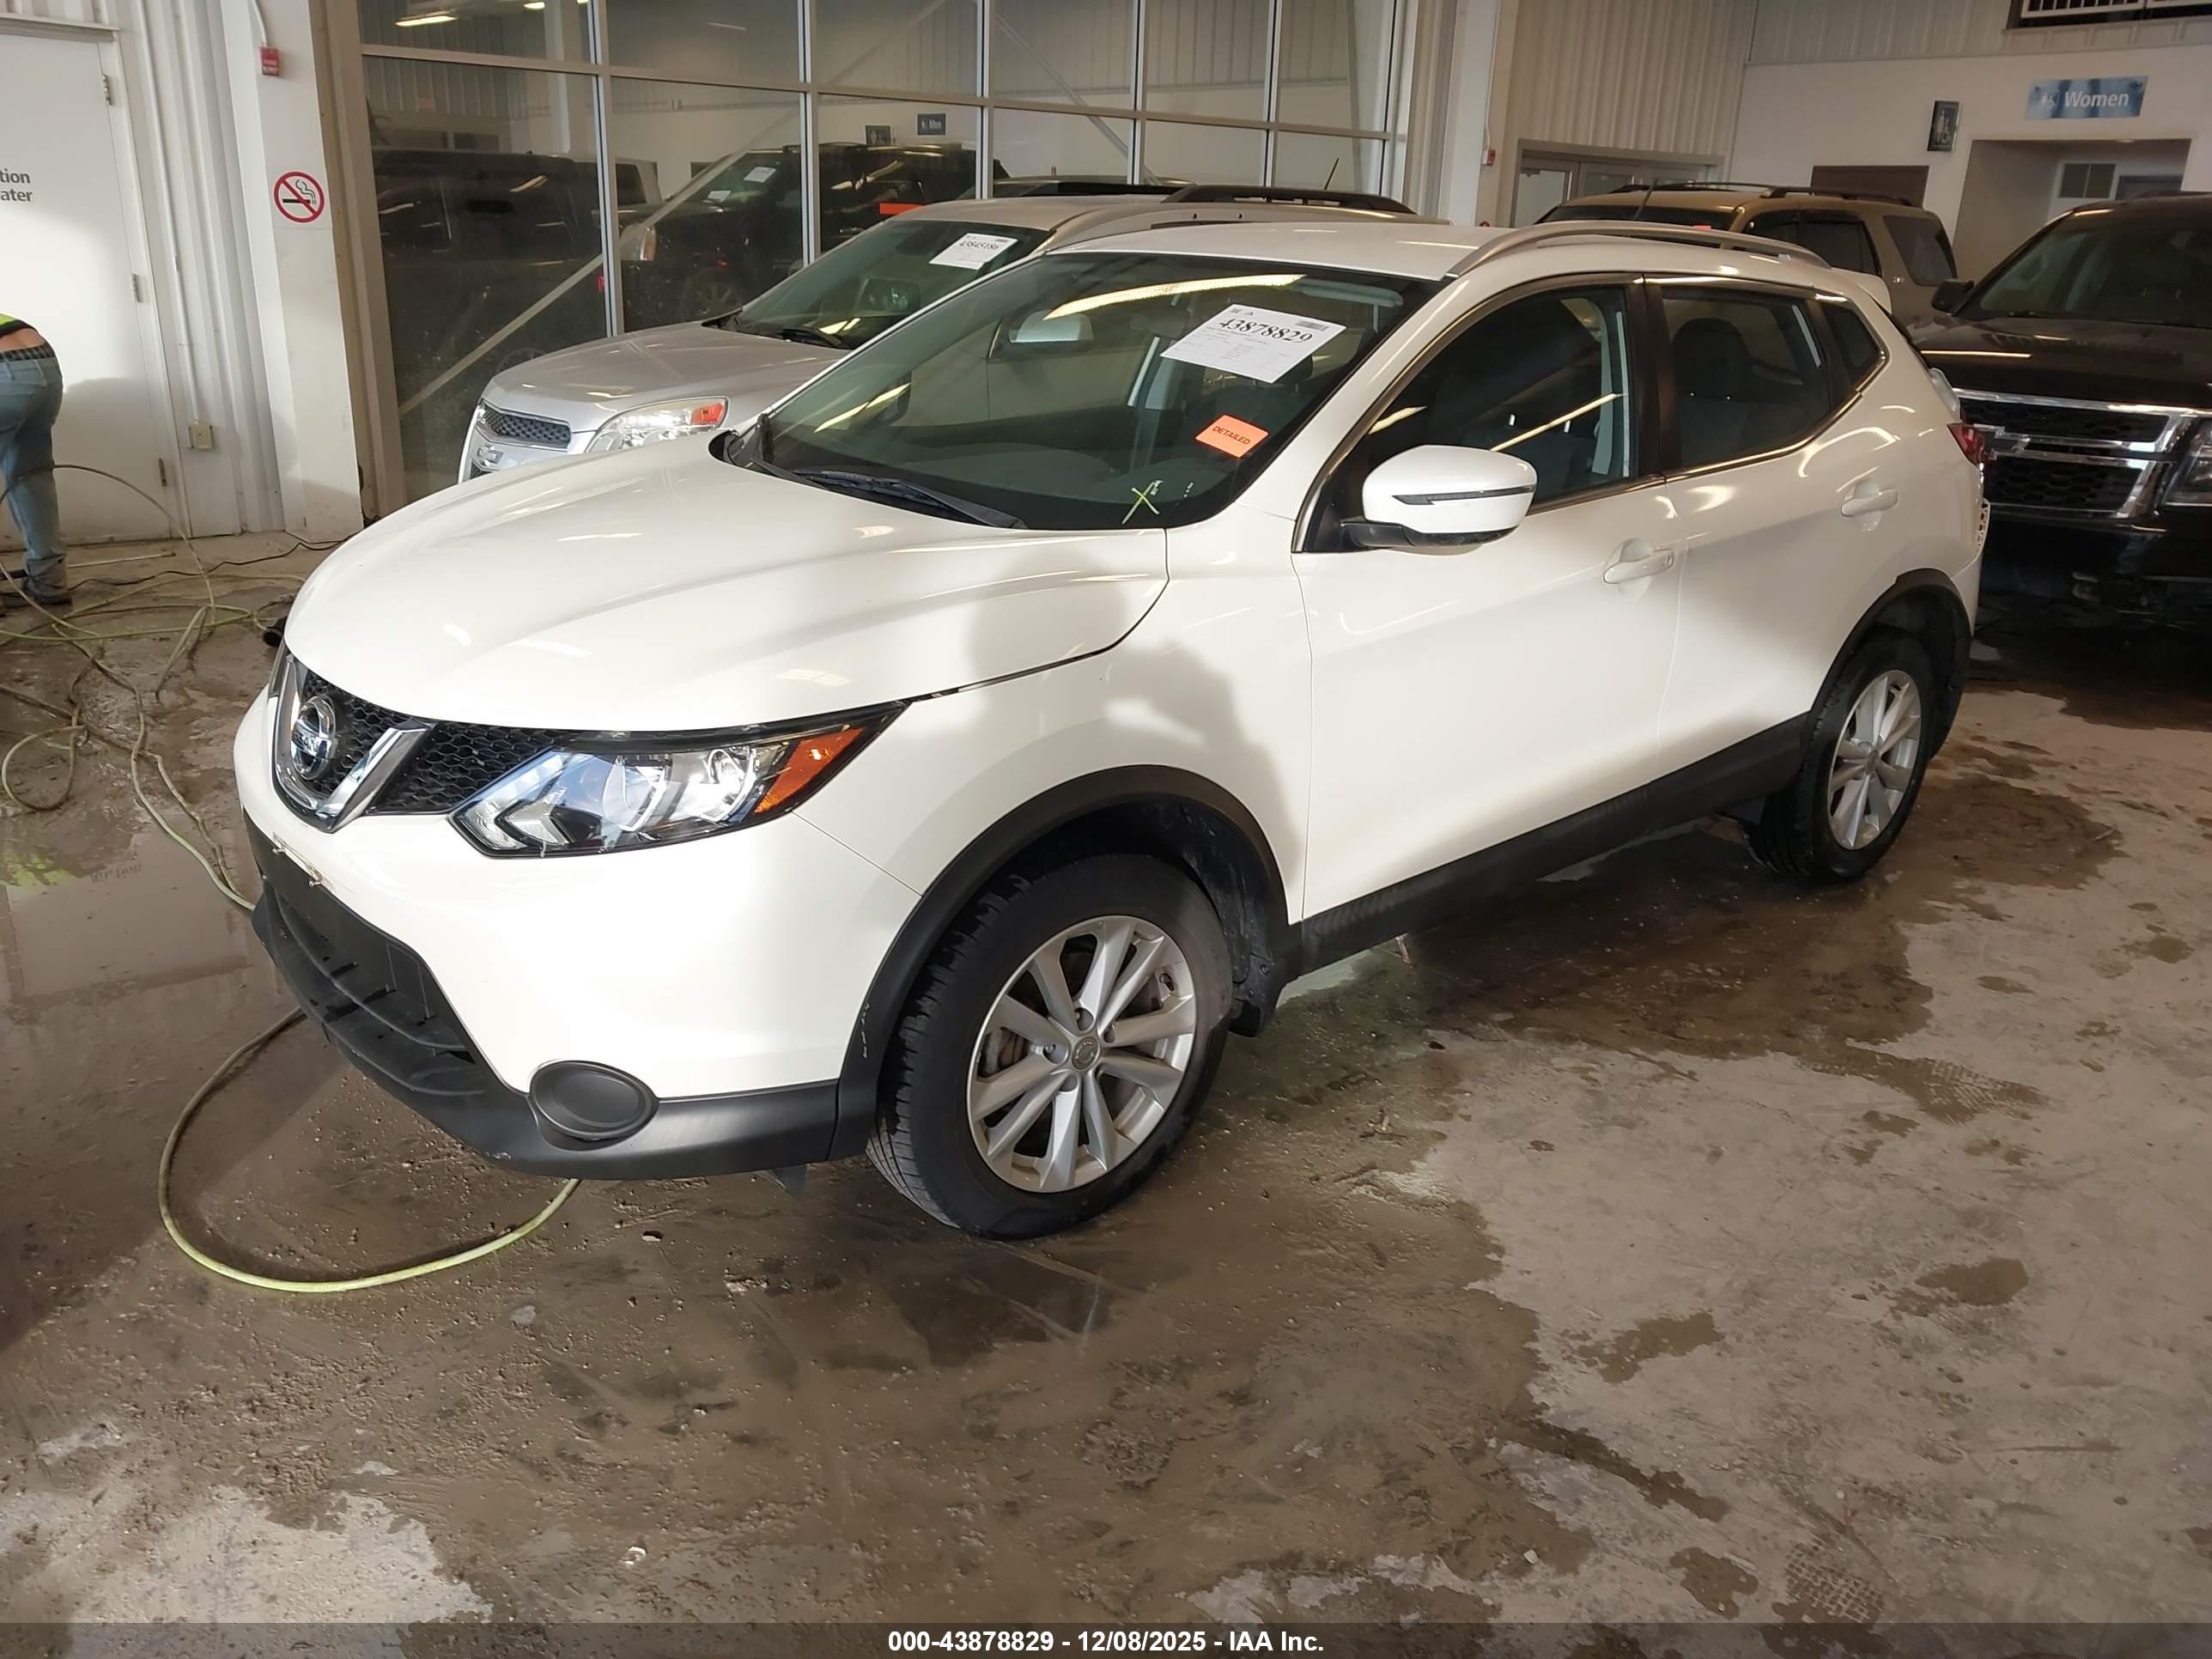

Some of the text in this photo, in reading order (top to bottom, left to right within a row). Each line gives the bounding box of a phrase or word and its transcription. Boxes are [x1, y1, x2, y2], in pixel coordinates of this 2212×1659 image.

[2064, 91, 2130, 107] Women
[0, 167, 31, 184] tion
[0, 188, 33, 202] ater
[1219, 318, 1313, 343] 43878829
[1212, 426, 1251, 445] DETAILED
